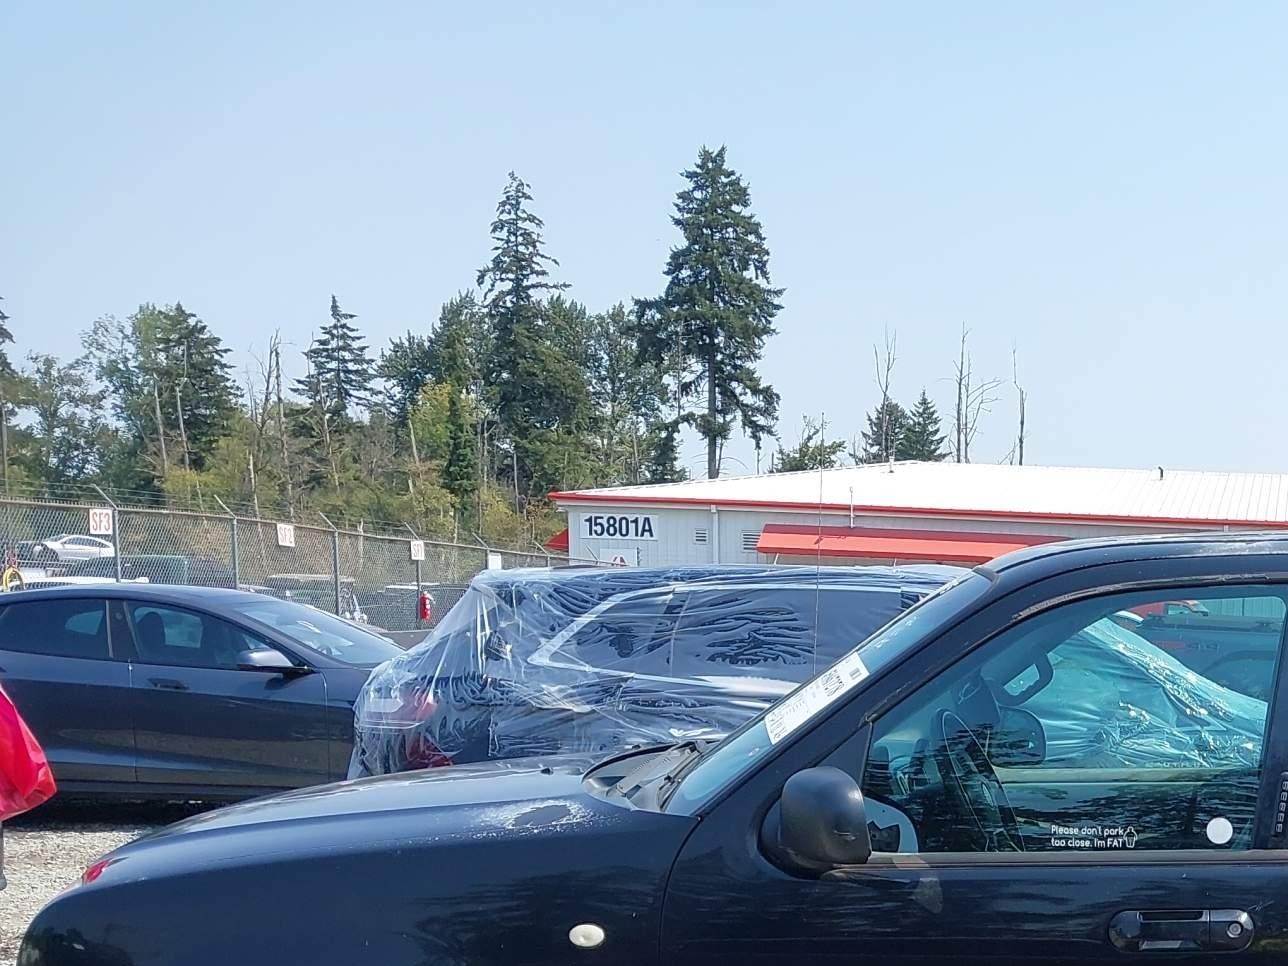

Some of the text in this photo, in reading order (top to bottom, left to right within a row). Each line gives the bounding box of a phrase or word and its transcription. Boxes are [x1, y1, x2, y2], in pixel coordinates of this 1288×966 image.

[92, 511, 111, 531] SF3
[584, 515, 654, 538] 15801A
[1051, 824, 1124, 838] Please don't park
[1051, 836, 1123, 848] too close. I'm FAT
